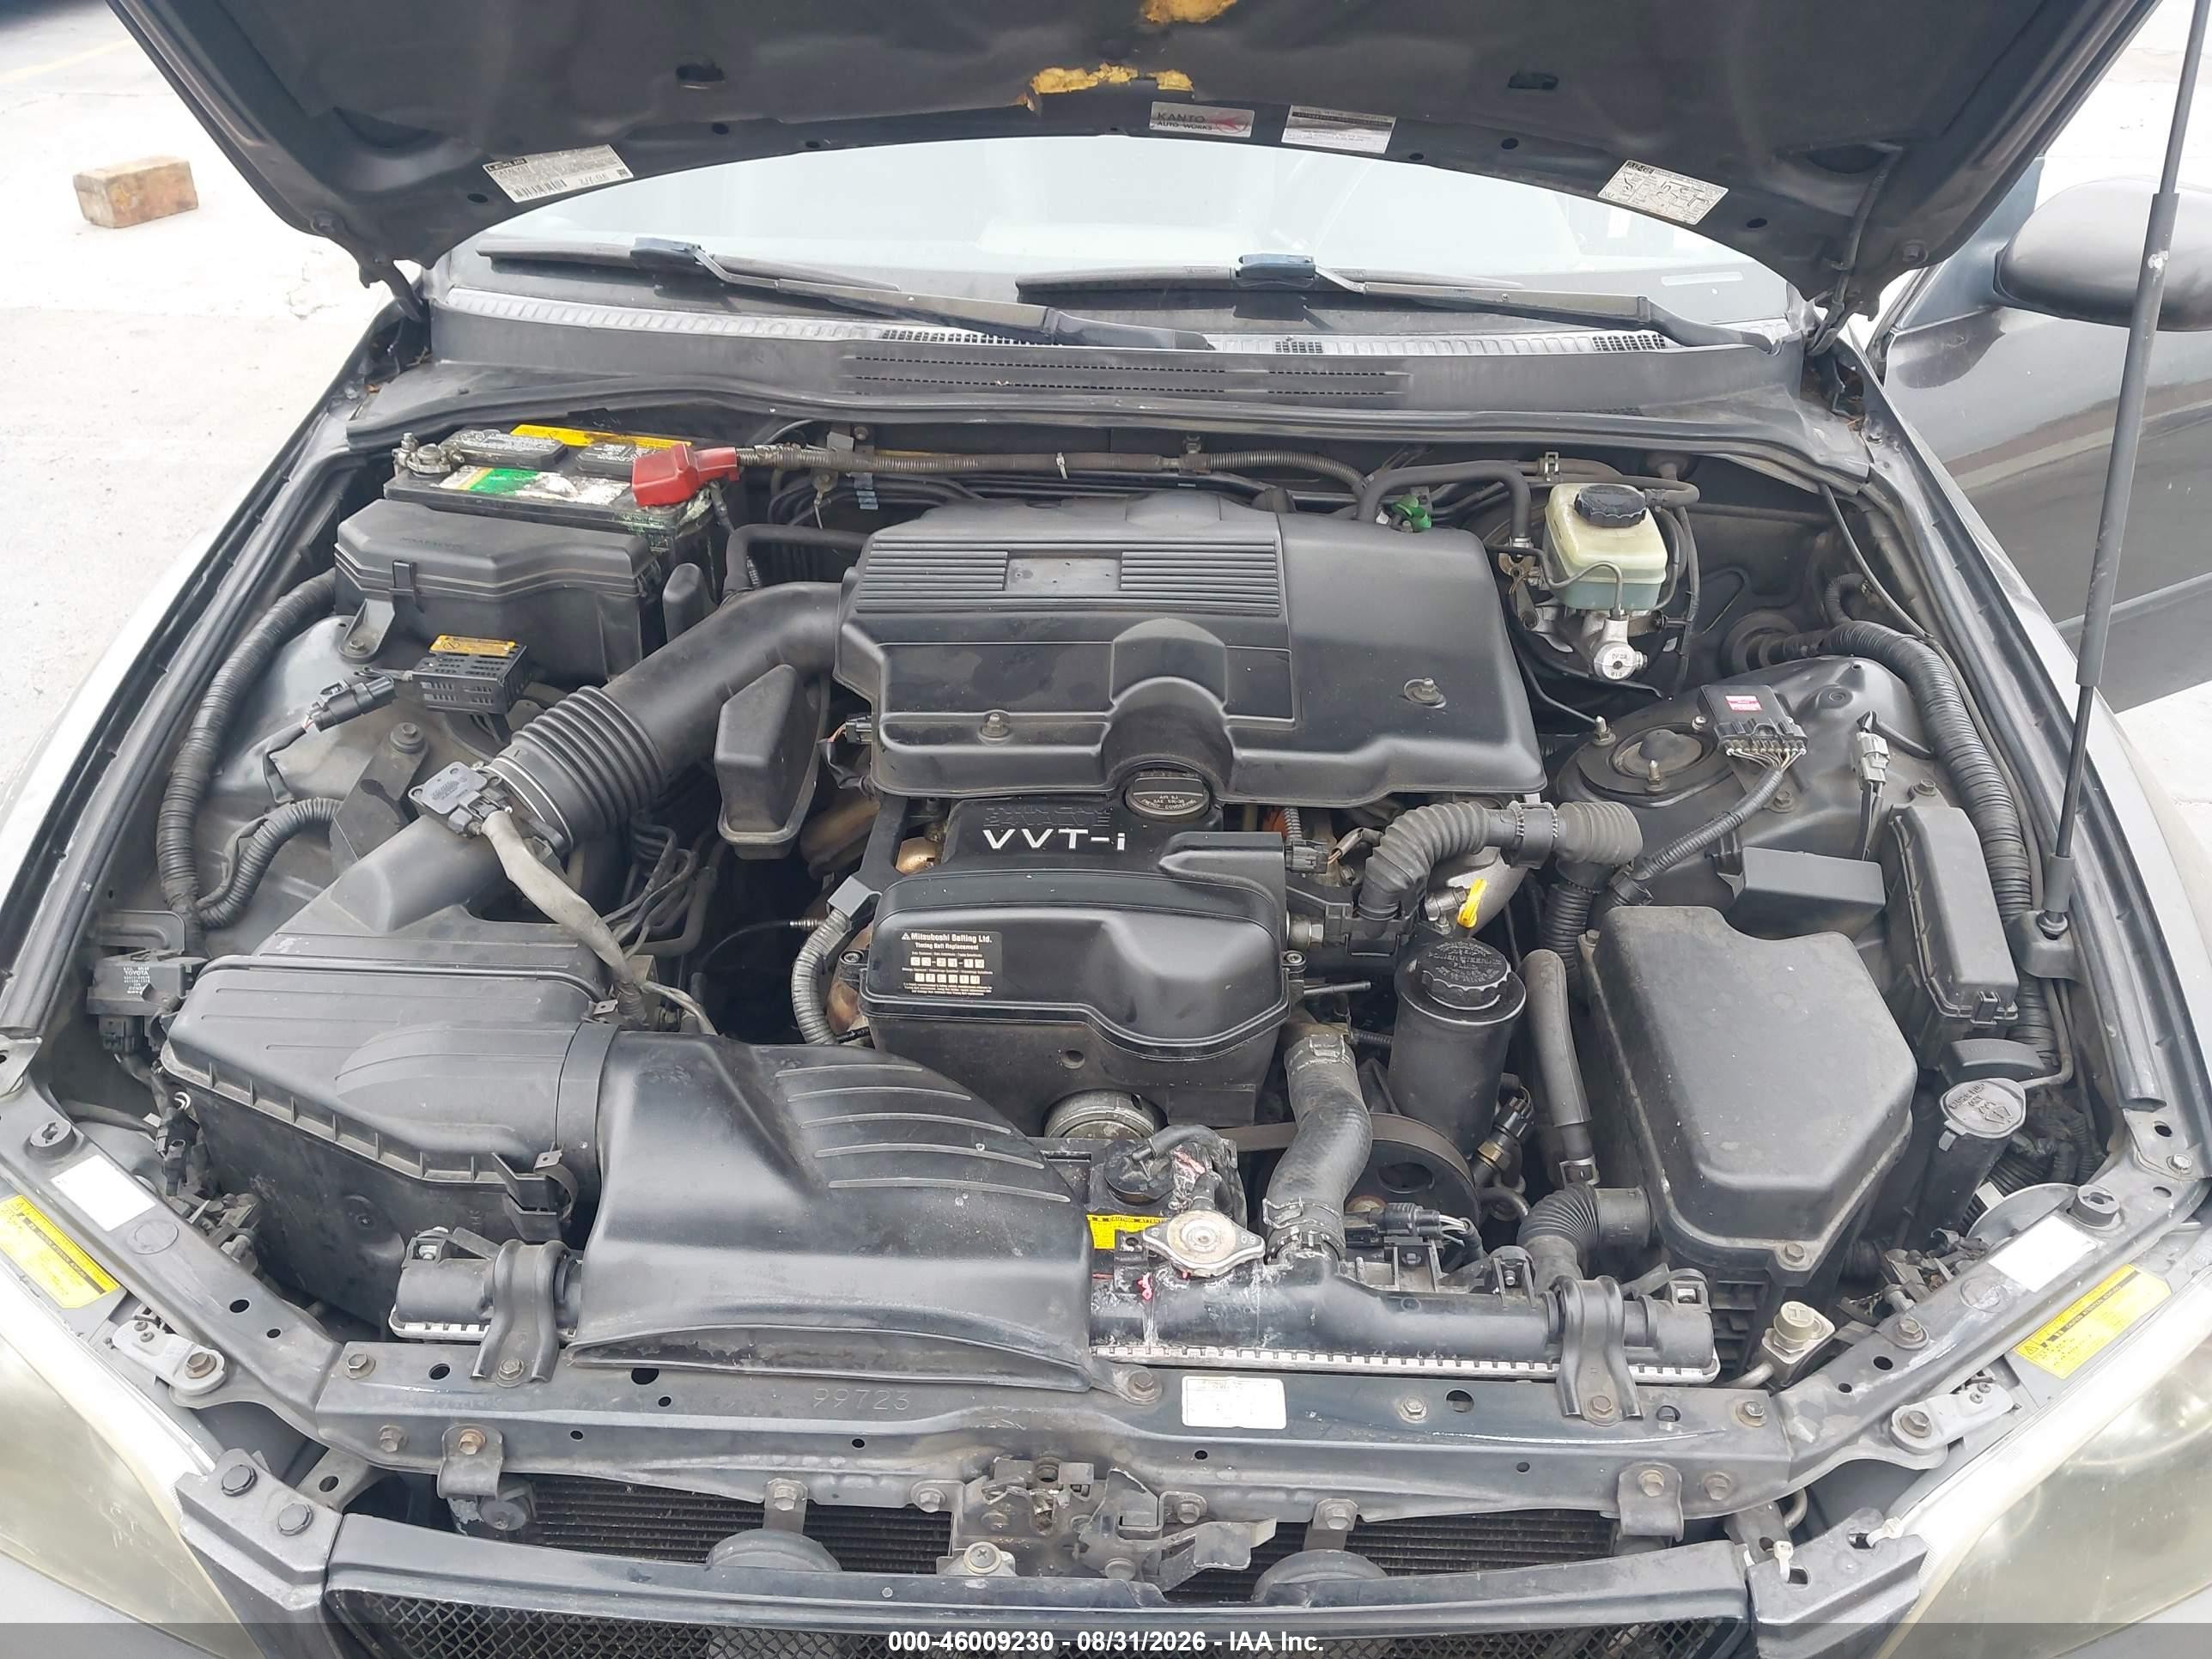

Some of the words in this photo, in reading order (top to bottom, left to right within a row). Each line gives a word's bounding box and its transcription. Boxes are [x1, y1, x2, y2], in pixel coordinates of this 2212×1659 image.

[1158, 112, 1206, 123] KANTO
[982, 828, 1126, 851] VVT-i
[978, 934, 993, 944] Ltd.
[812, 1387, 910, 1411] 99723
